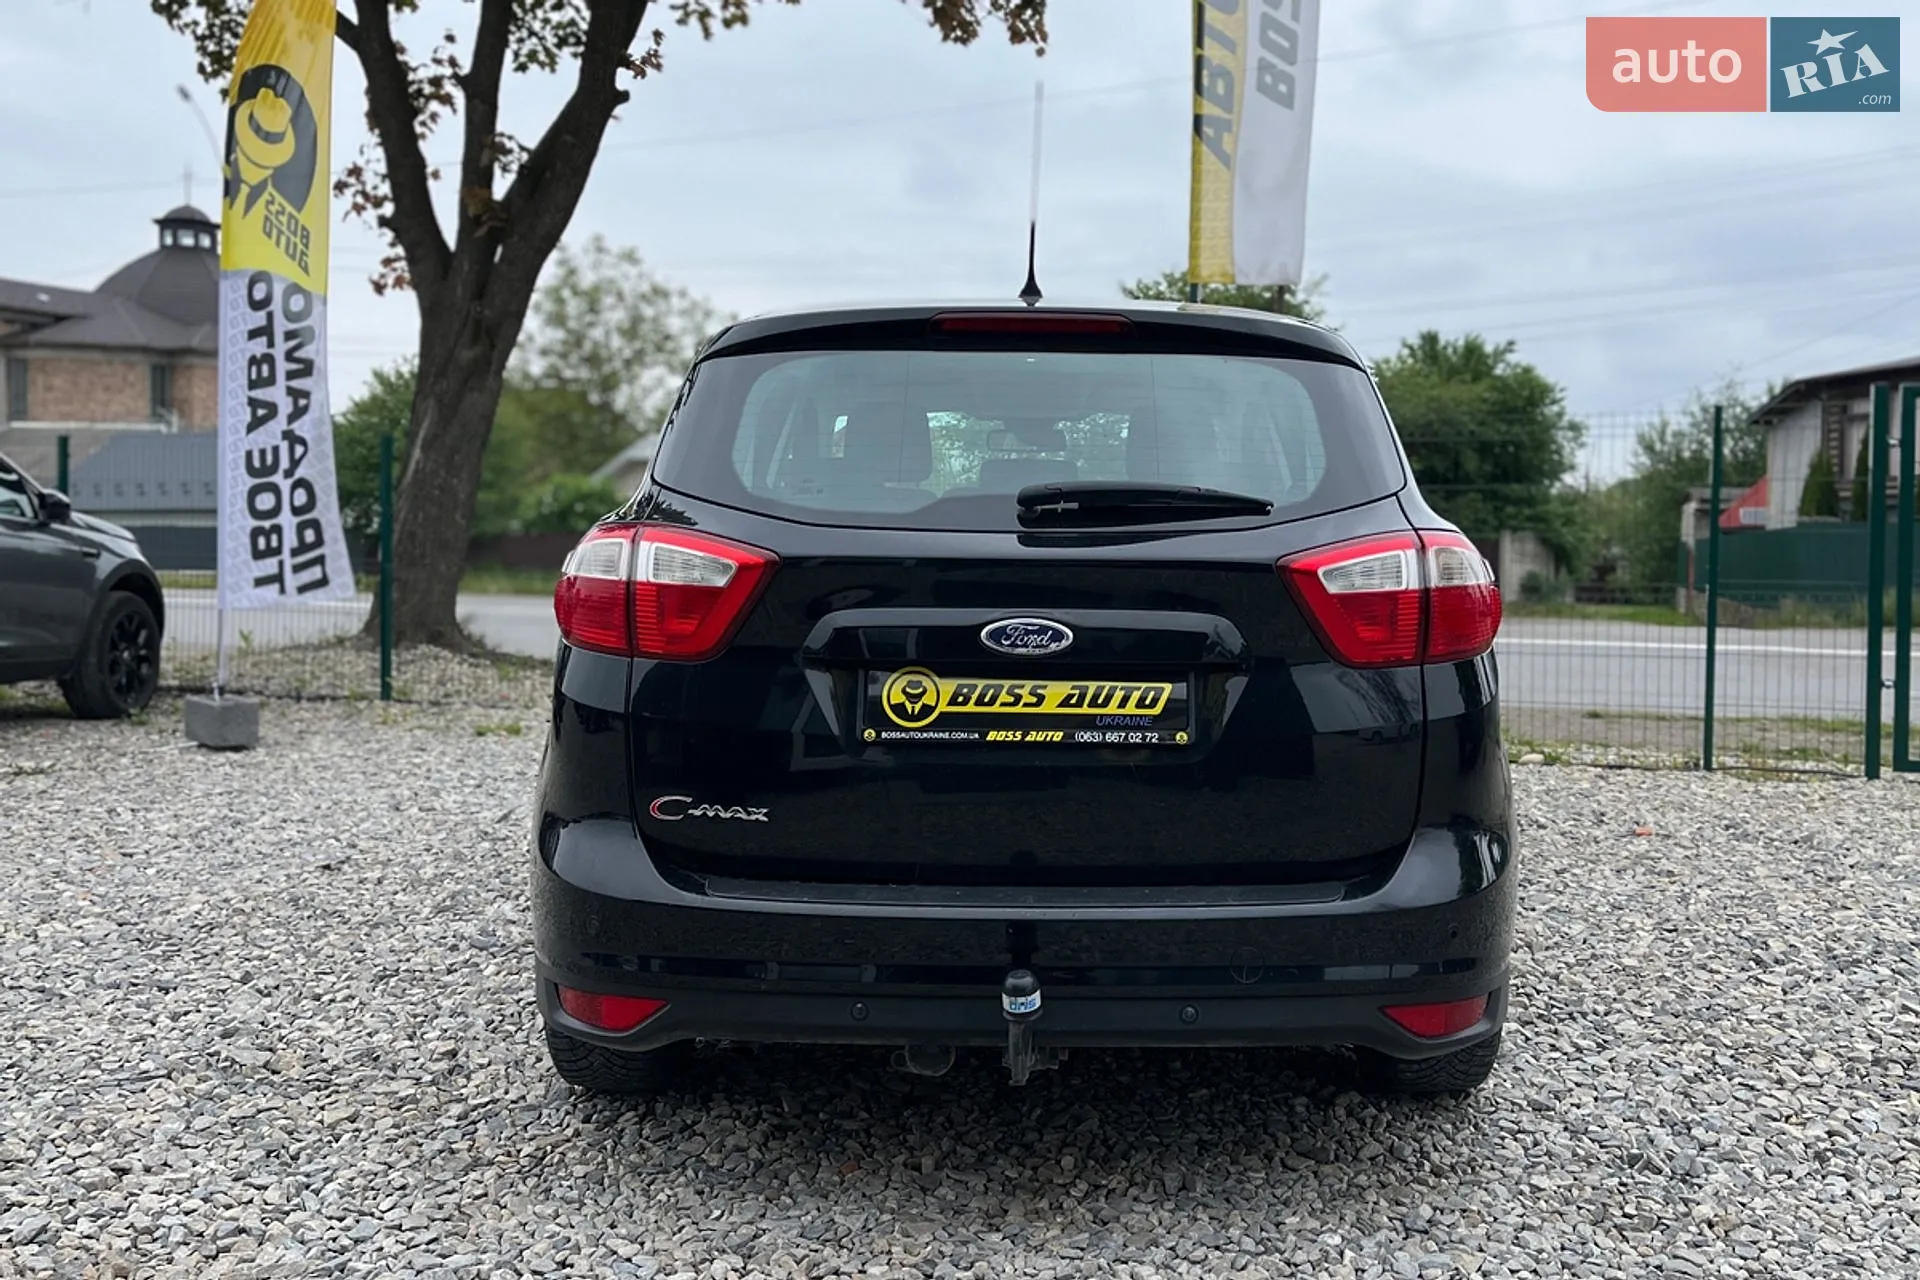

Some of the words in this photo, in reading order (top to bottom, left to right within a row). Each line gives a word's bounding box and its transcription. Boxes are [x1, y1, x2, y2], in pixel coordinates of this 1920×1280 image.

[1001, 624, 1053, 648] Ford
[946, 683, 1048, 709] BOSS
[1056, 685, 1165, 709] AUTO
[1095, 715, 1153, 727] UKRAINE
[986, 731, 1022, 741] BOSS
[1025, 731, 1064, 742] AUTO
[1075, 731, 1103, 743] (063)
[1106, 732, 1125, 743] 667
[1128, 733, 1142, 743] 02
[1145, 733, 1159, 743] 72
